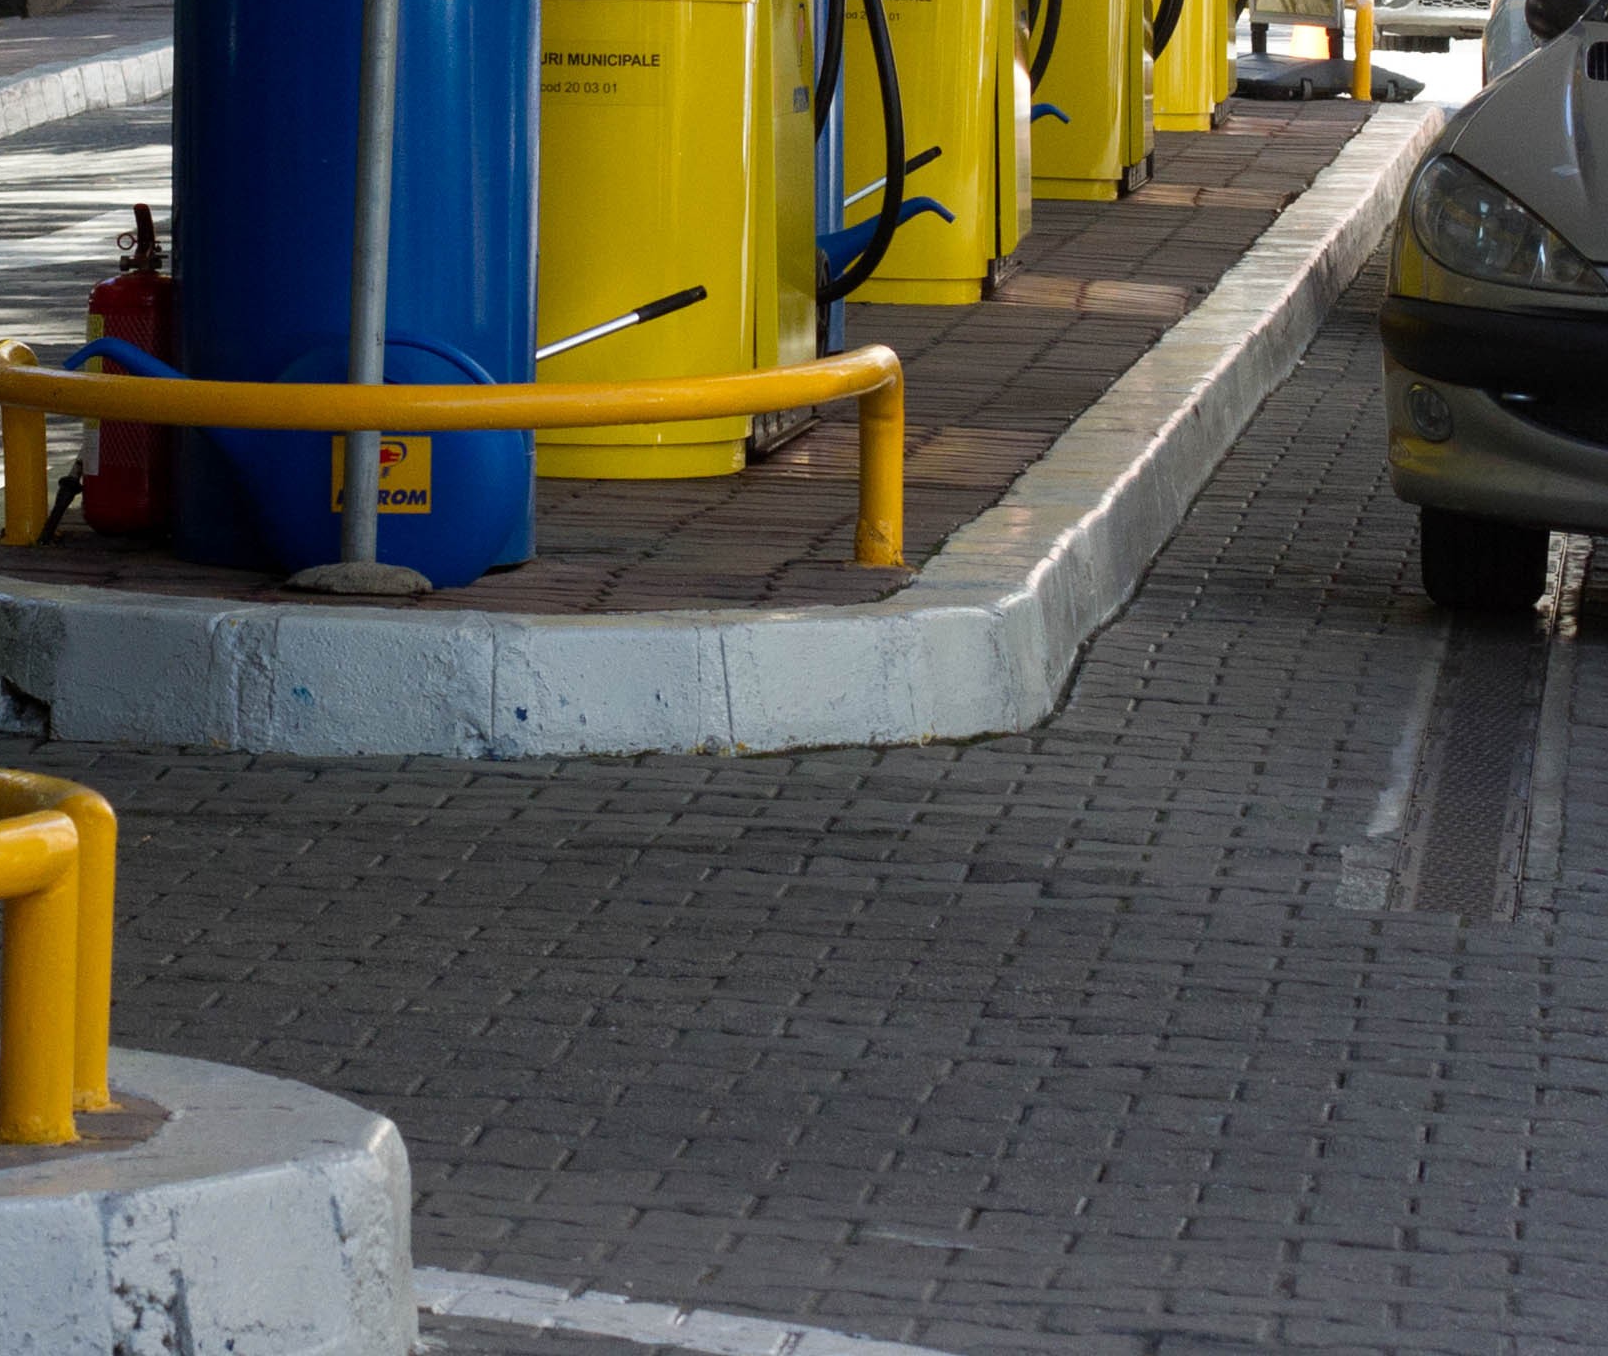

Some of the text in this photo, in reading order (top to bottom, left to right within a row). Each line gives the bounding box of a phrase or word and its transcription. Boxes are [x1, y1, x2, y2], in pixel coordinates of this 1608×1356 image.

[567, 53, 660, 67] MUNICIPALE
[540, 81, 617, 94] cod 20 03 01
[336, 489, 427, 505] ROM
